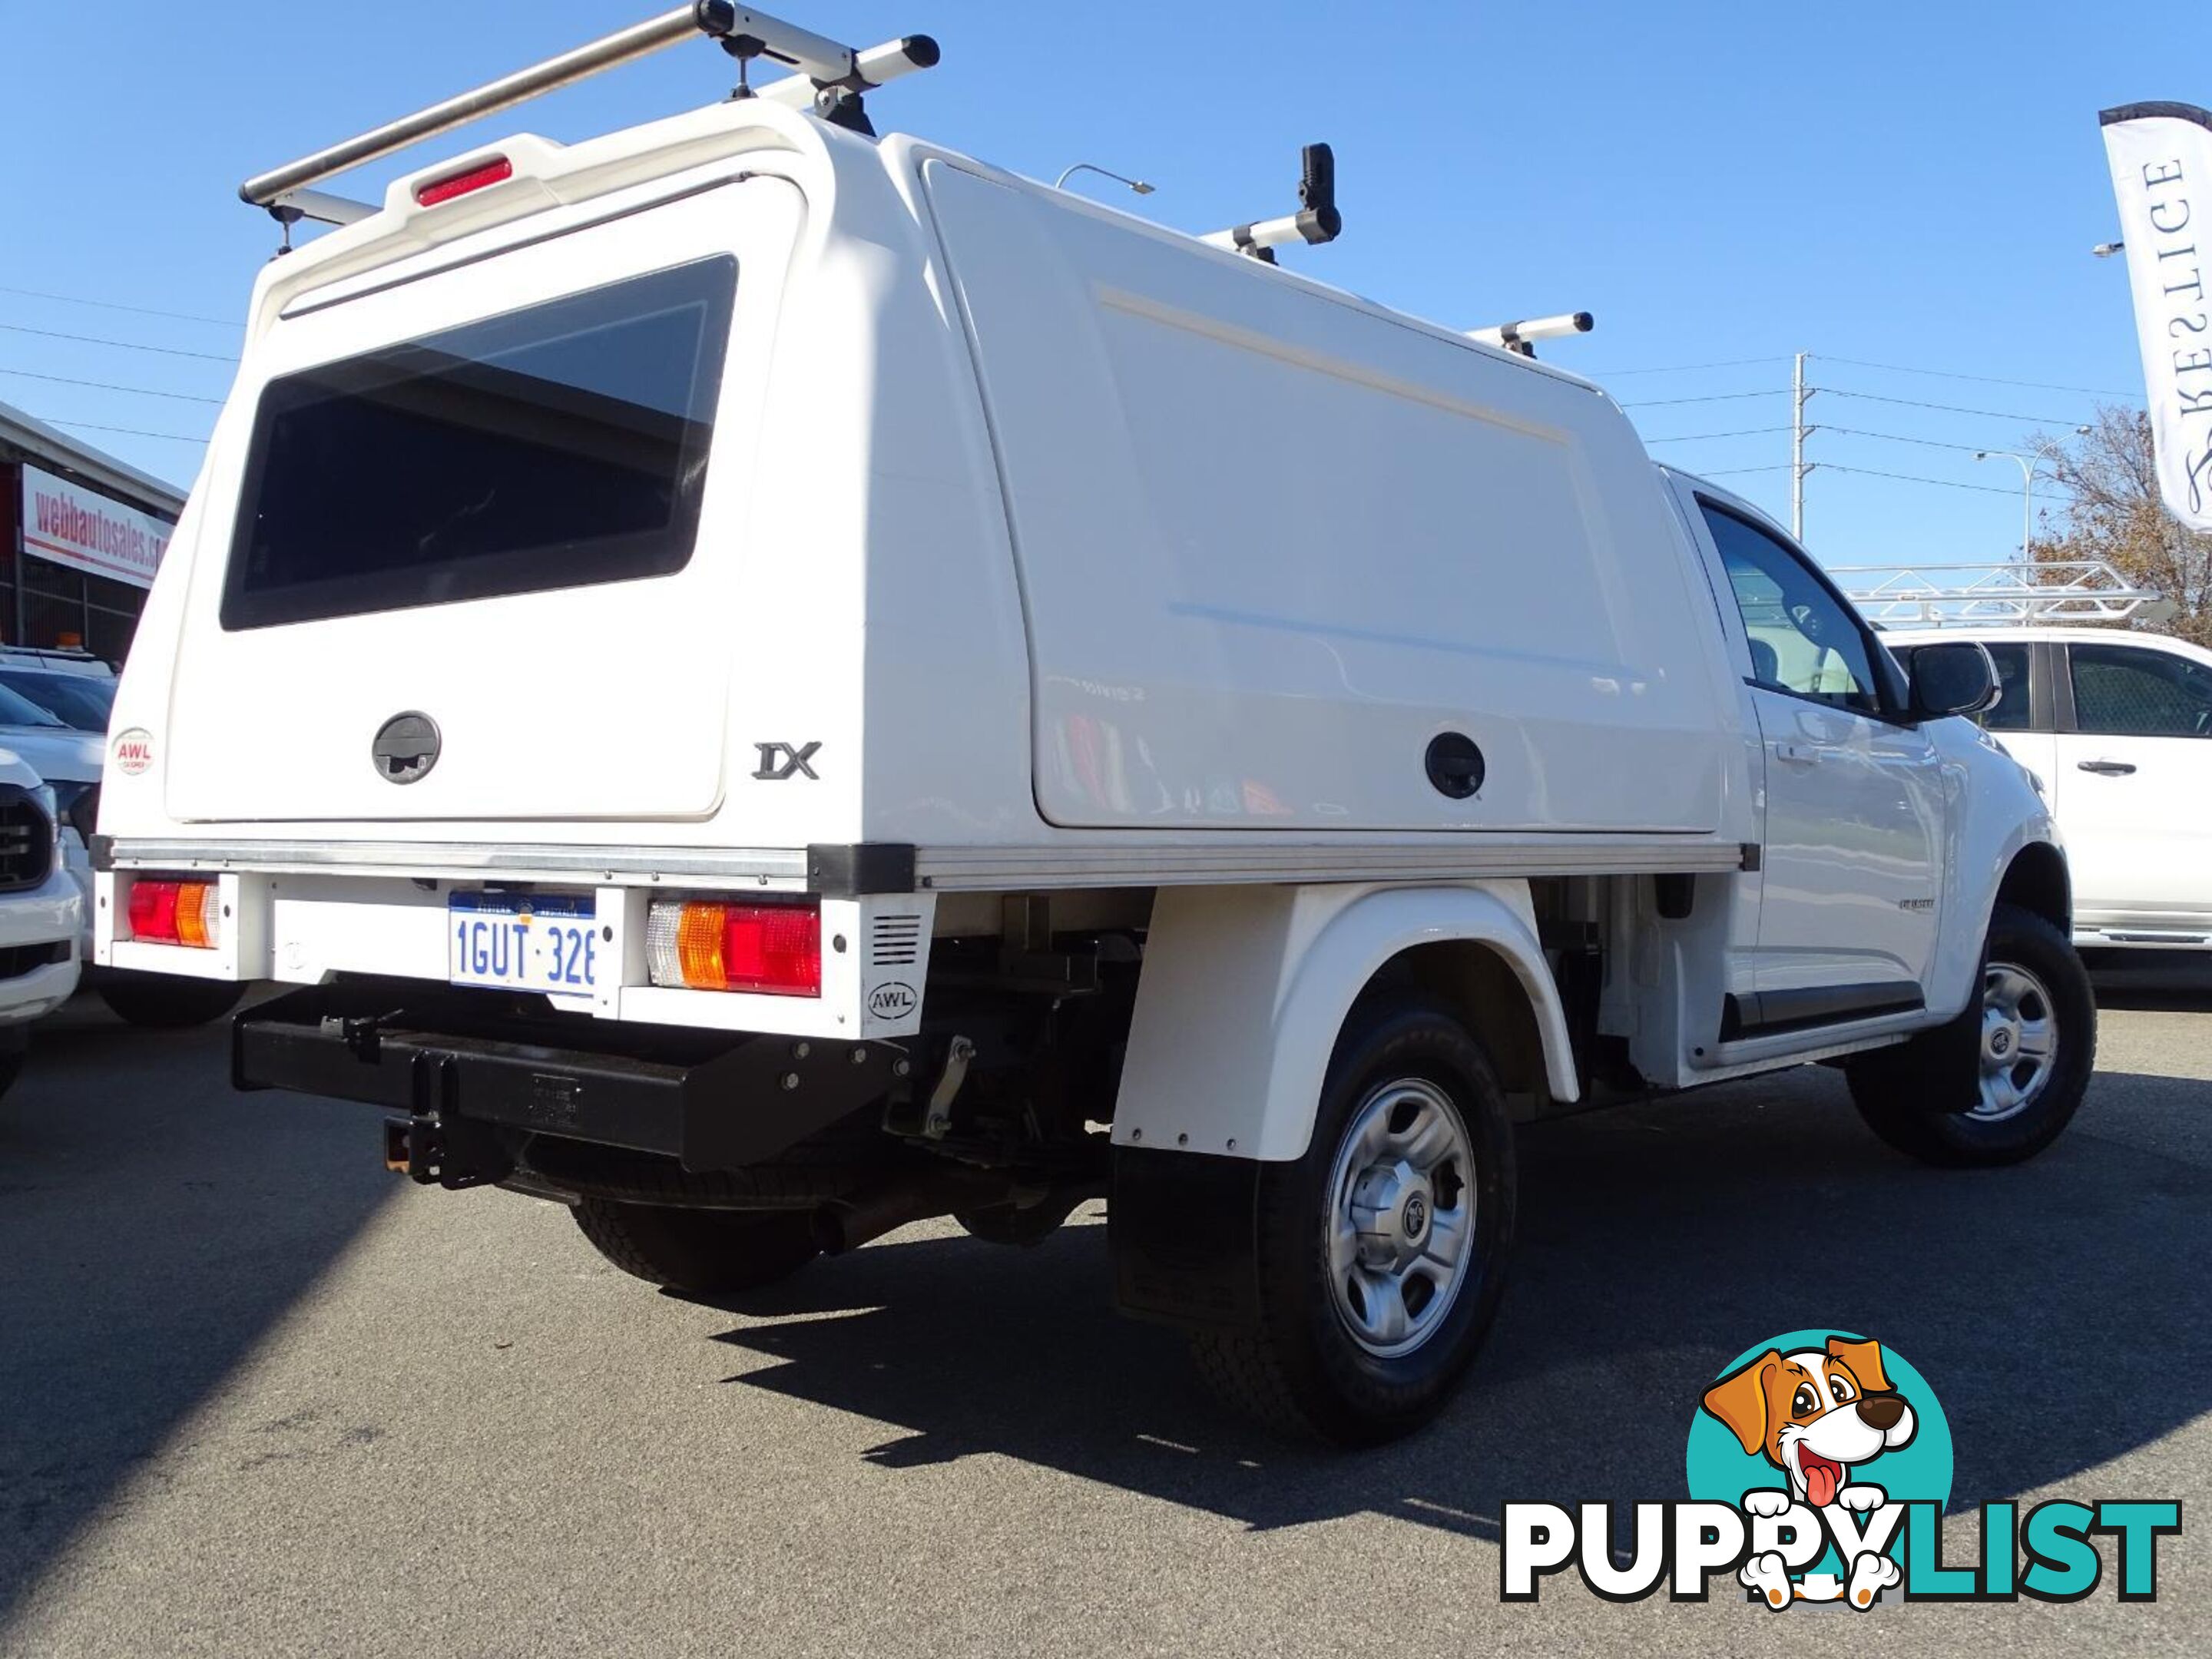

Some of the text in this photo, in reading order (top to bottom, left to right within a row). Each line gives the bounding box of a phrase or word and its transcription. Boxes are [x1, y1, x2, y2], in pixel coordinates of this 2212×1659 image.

[118, 743, 151, 760] AWL
[458, 921, 529, 979] 1GUT
[872, 992, 912, 1008] AWL
